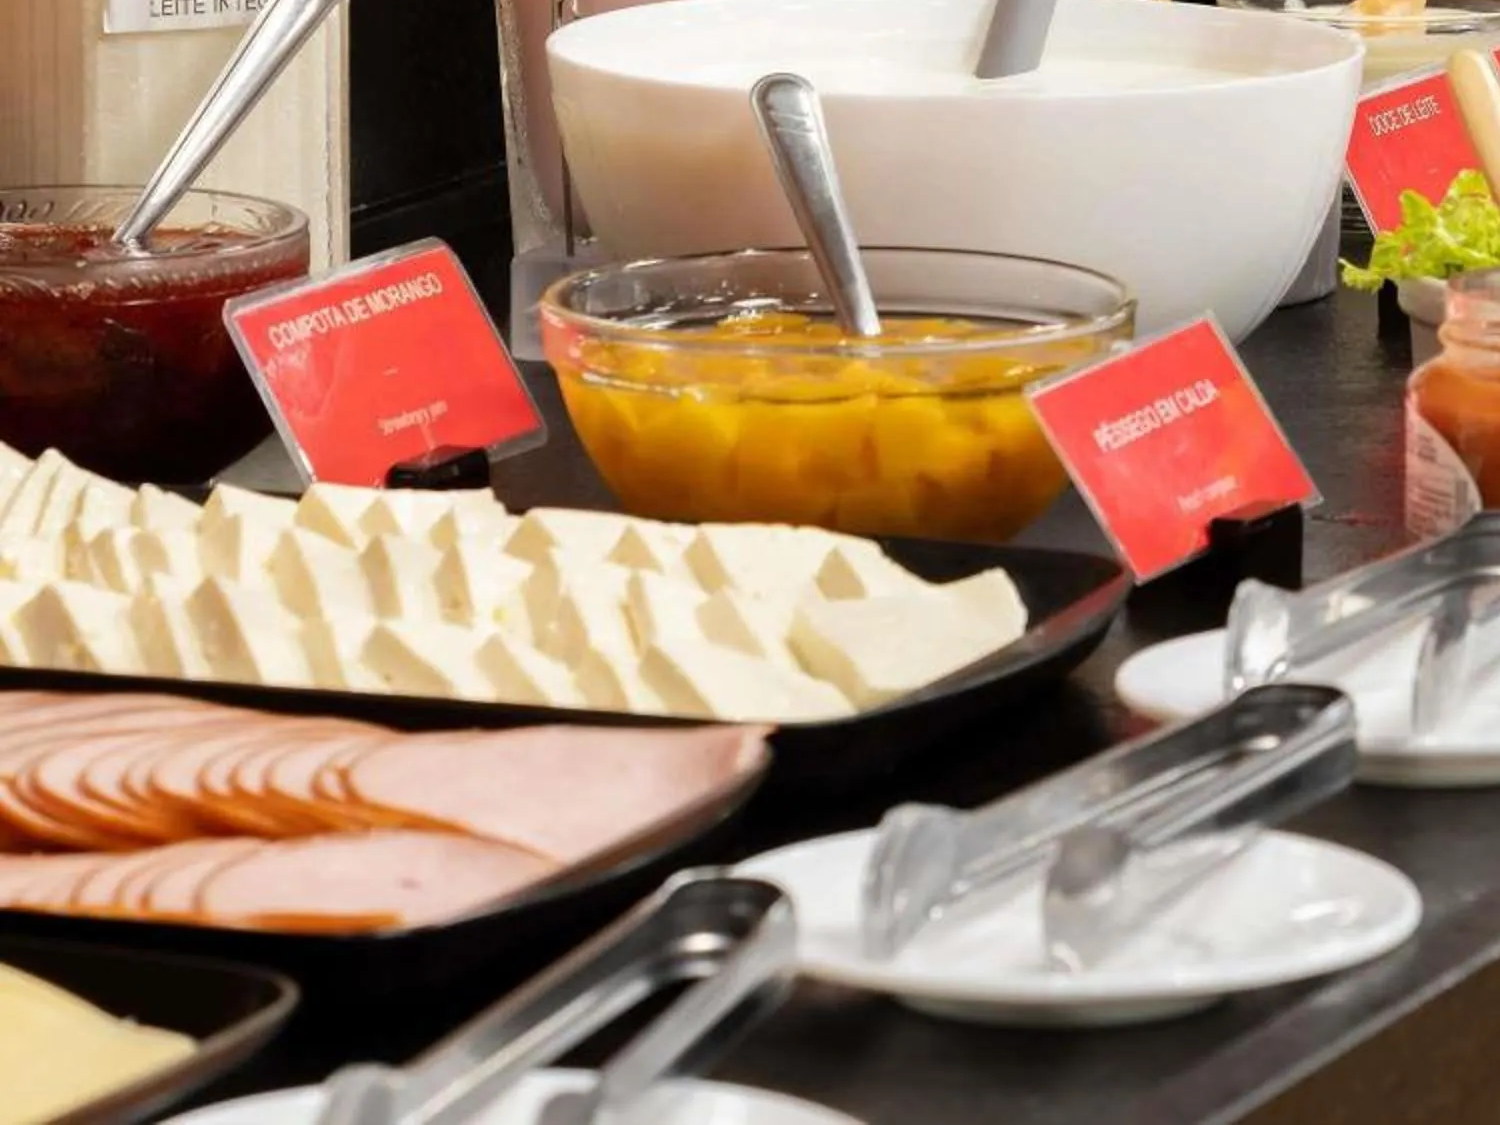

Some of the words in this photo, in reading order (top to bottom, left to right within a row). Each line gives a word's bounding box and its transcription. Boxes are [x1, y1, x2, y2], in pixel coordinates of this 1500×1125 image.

[268, 302, 347, 349] COMPOTA
[343, 296, 372, 324] DE
[370, 273, 443, 315] MORANGO
